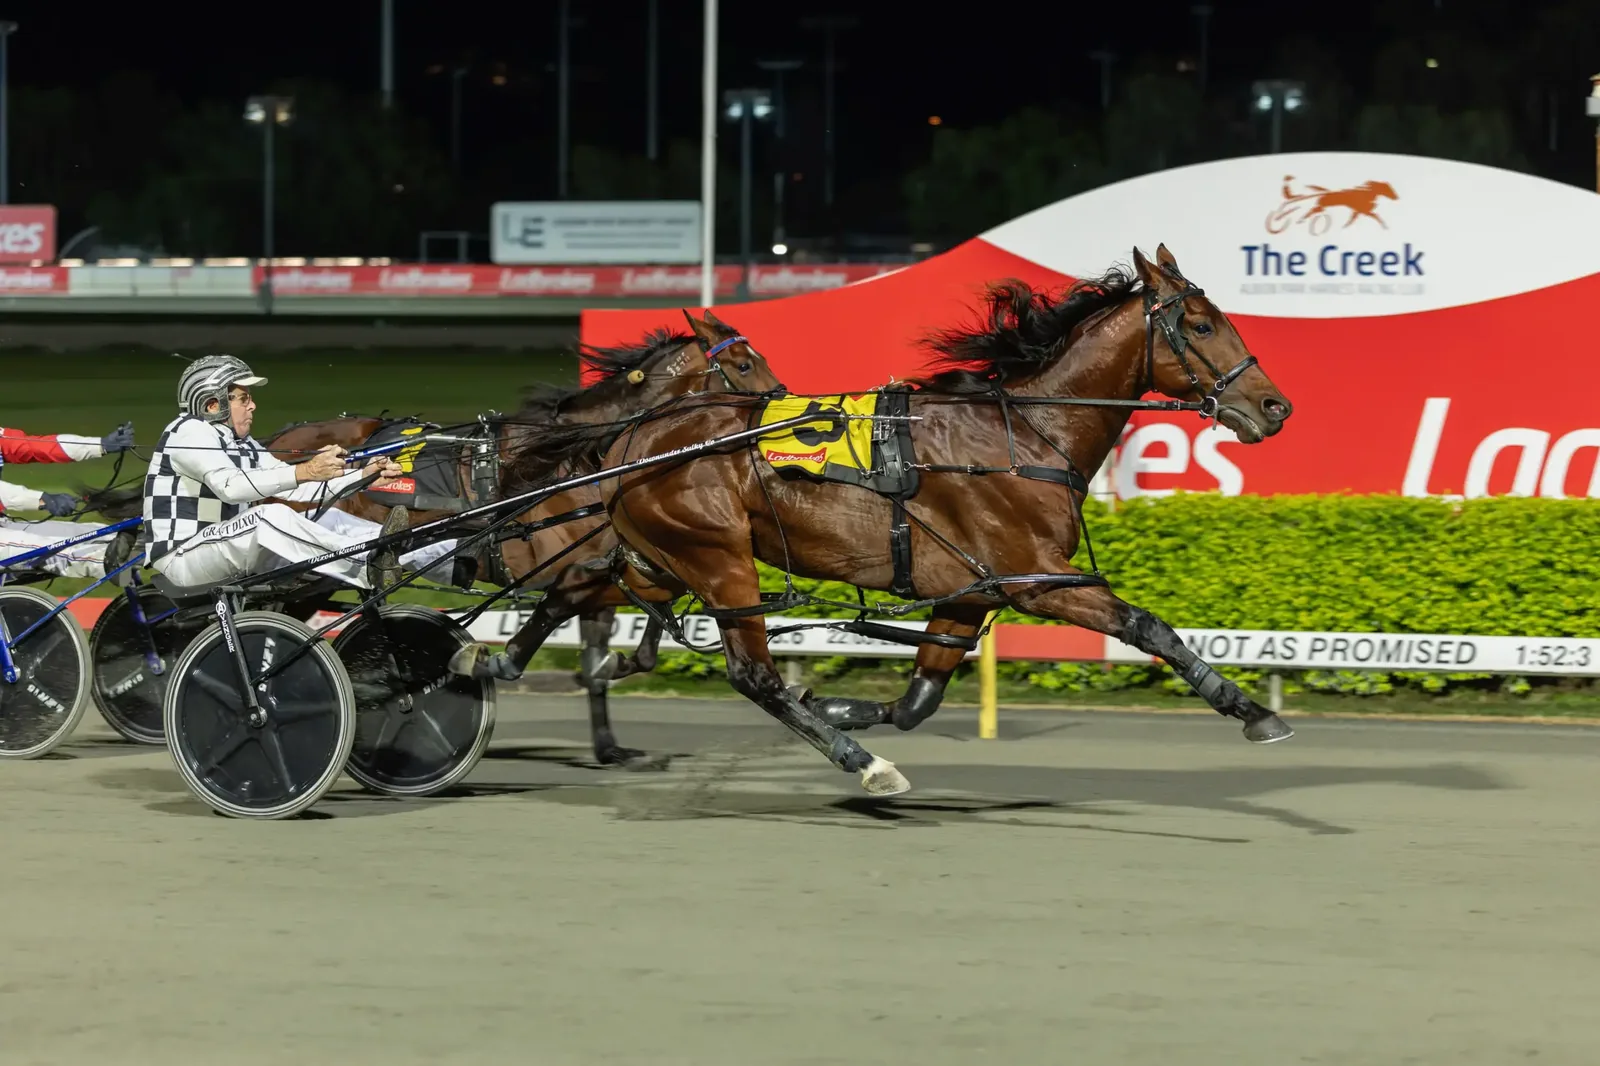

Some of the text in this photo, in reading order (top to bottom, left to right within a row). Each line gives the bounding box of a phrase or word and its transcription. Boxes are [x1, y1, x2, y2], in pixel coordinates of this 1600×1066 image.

[1241, 243, 1425, 276] The Creek
[1115, 423, 1244, 500] es
[202, 510, 263, 539] GRAT DIXON
[308, 542, 366, 564] Dixon Racing
[214, 600, 236, 653] AVENGER
[1187, 635, 1251, 659] NOT
[1257, 636, 1298, 660] AS
[1307, 637, 1477, 665] PROMISED
